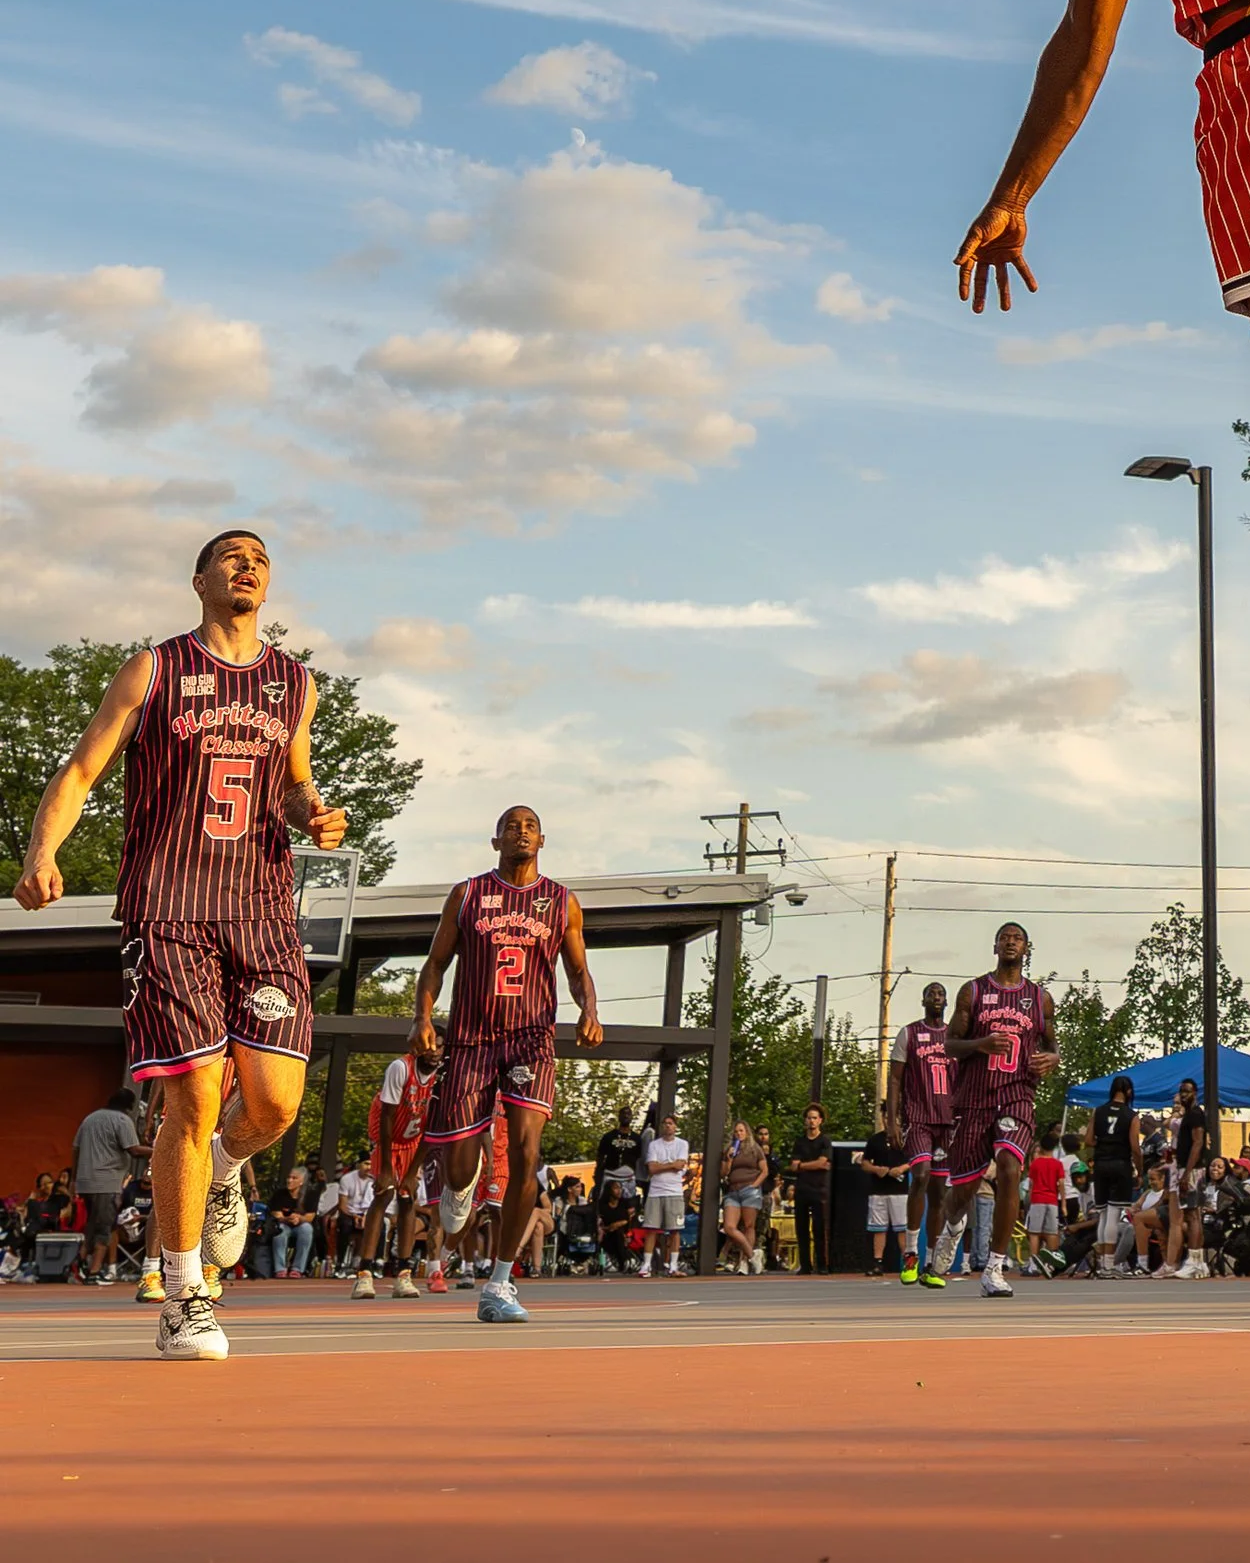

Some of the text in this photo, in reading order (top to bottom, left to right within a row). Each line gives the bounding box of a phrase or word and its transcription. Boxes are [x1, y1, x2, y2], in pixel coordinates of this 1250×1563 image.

[180, 673, 215, 687] END GUN
[182, 685, 216, 698] VIOLENCE
[172, 701, 290, 747] Heritage
[201, 735, 270, 756] Classic
[203, 758, 254, 841] 5
[474, 911, 552, 940] Heritage
[491, 932, 536, 946] Classic
[495, 946, 526, 996] 2
[243, 994, 296, 1018] Heritage
[979, 1006, 1033, 1030] Heritage
[931, 1064, 948, 1094] 11
[1107, 1116, 1118, 1134] 7
